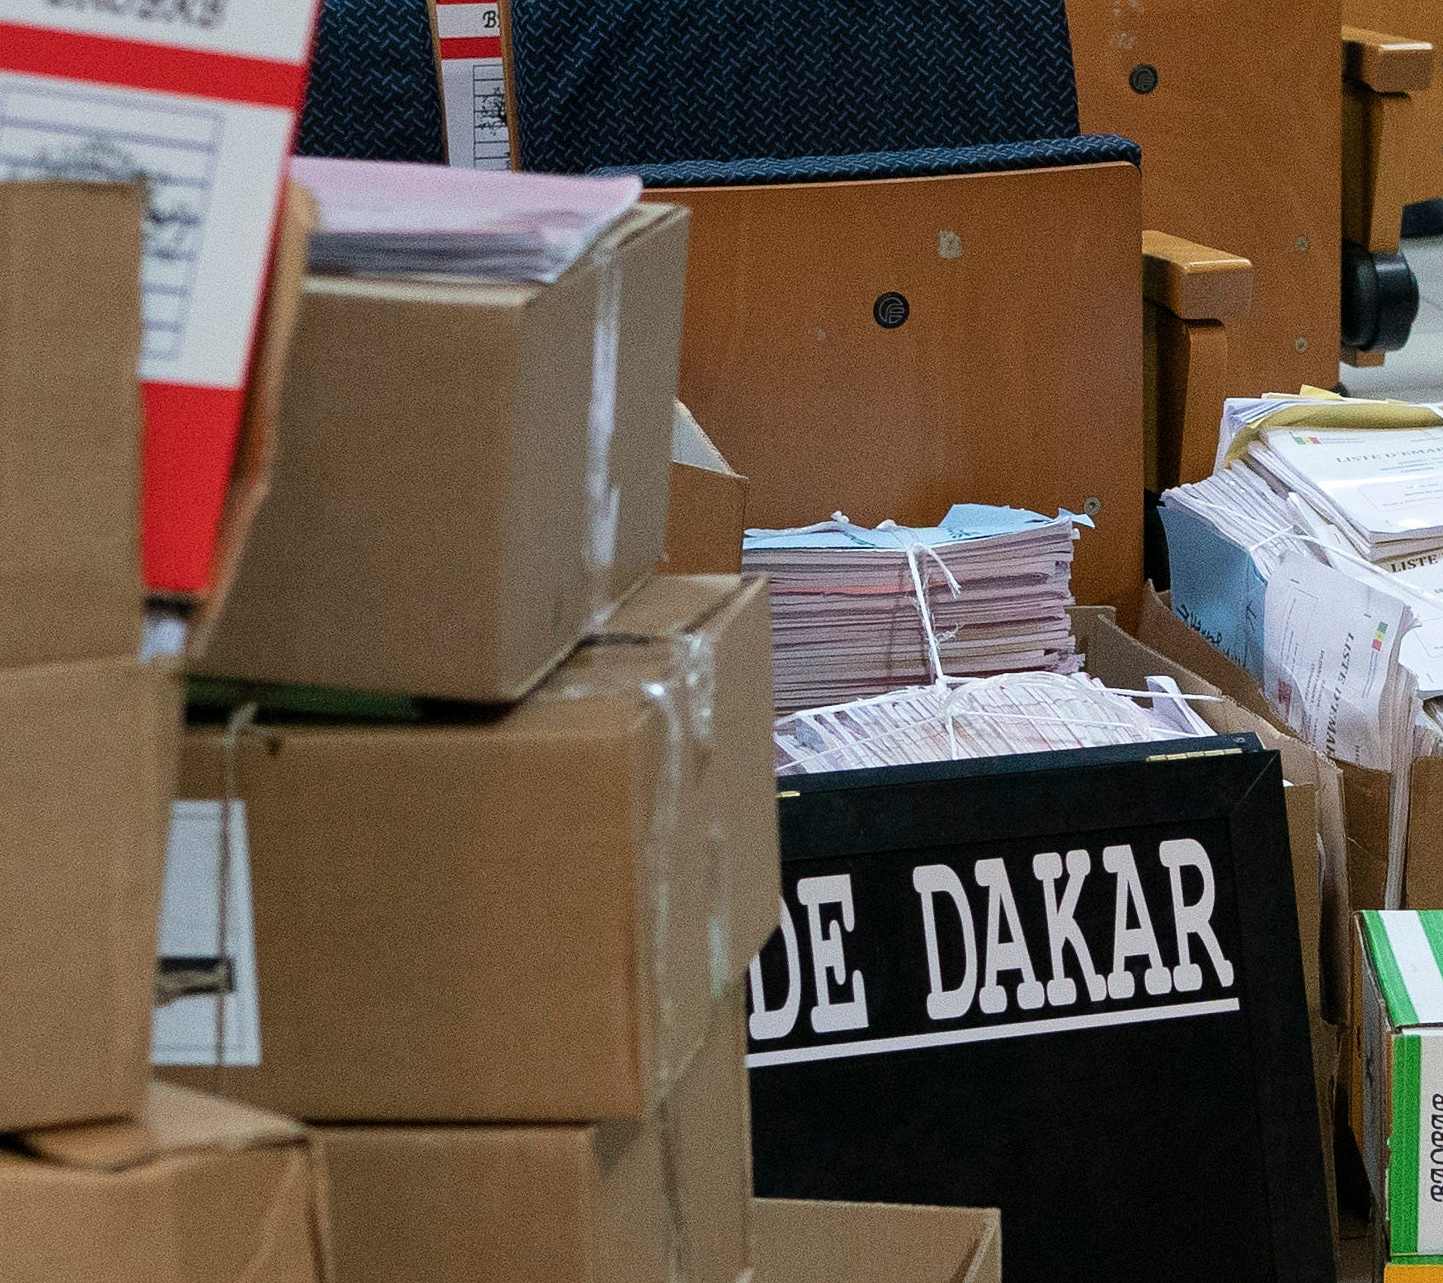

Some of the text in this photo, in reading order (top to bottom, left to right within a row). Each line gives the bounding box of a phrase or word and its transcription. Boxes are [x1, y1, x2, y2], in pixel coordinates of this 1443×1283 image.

[1391, 554, 1439, 573] LISTE
[1341, 632, 1355, 684] LISTE
[748, 837, 1235, 1040] DE DAKAR
